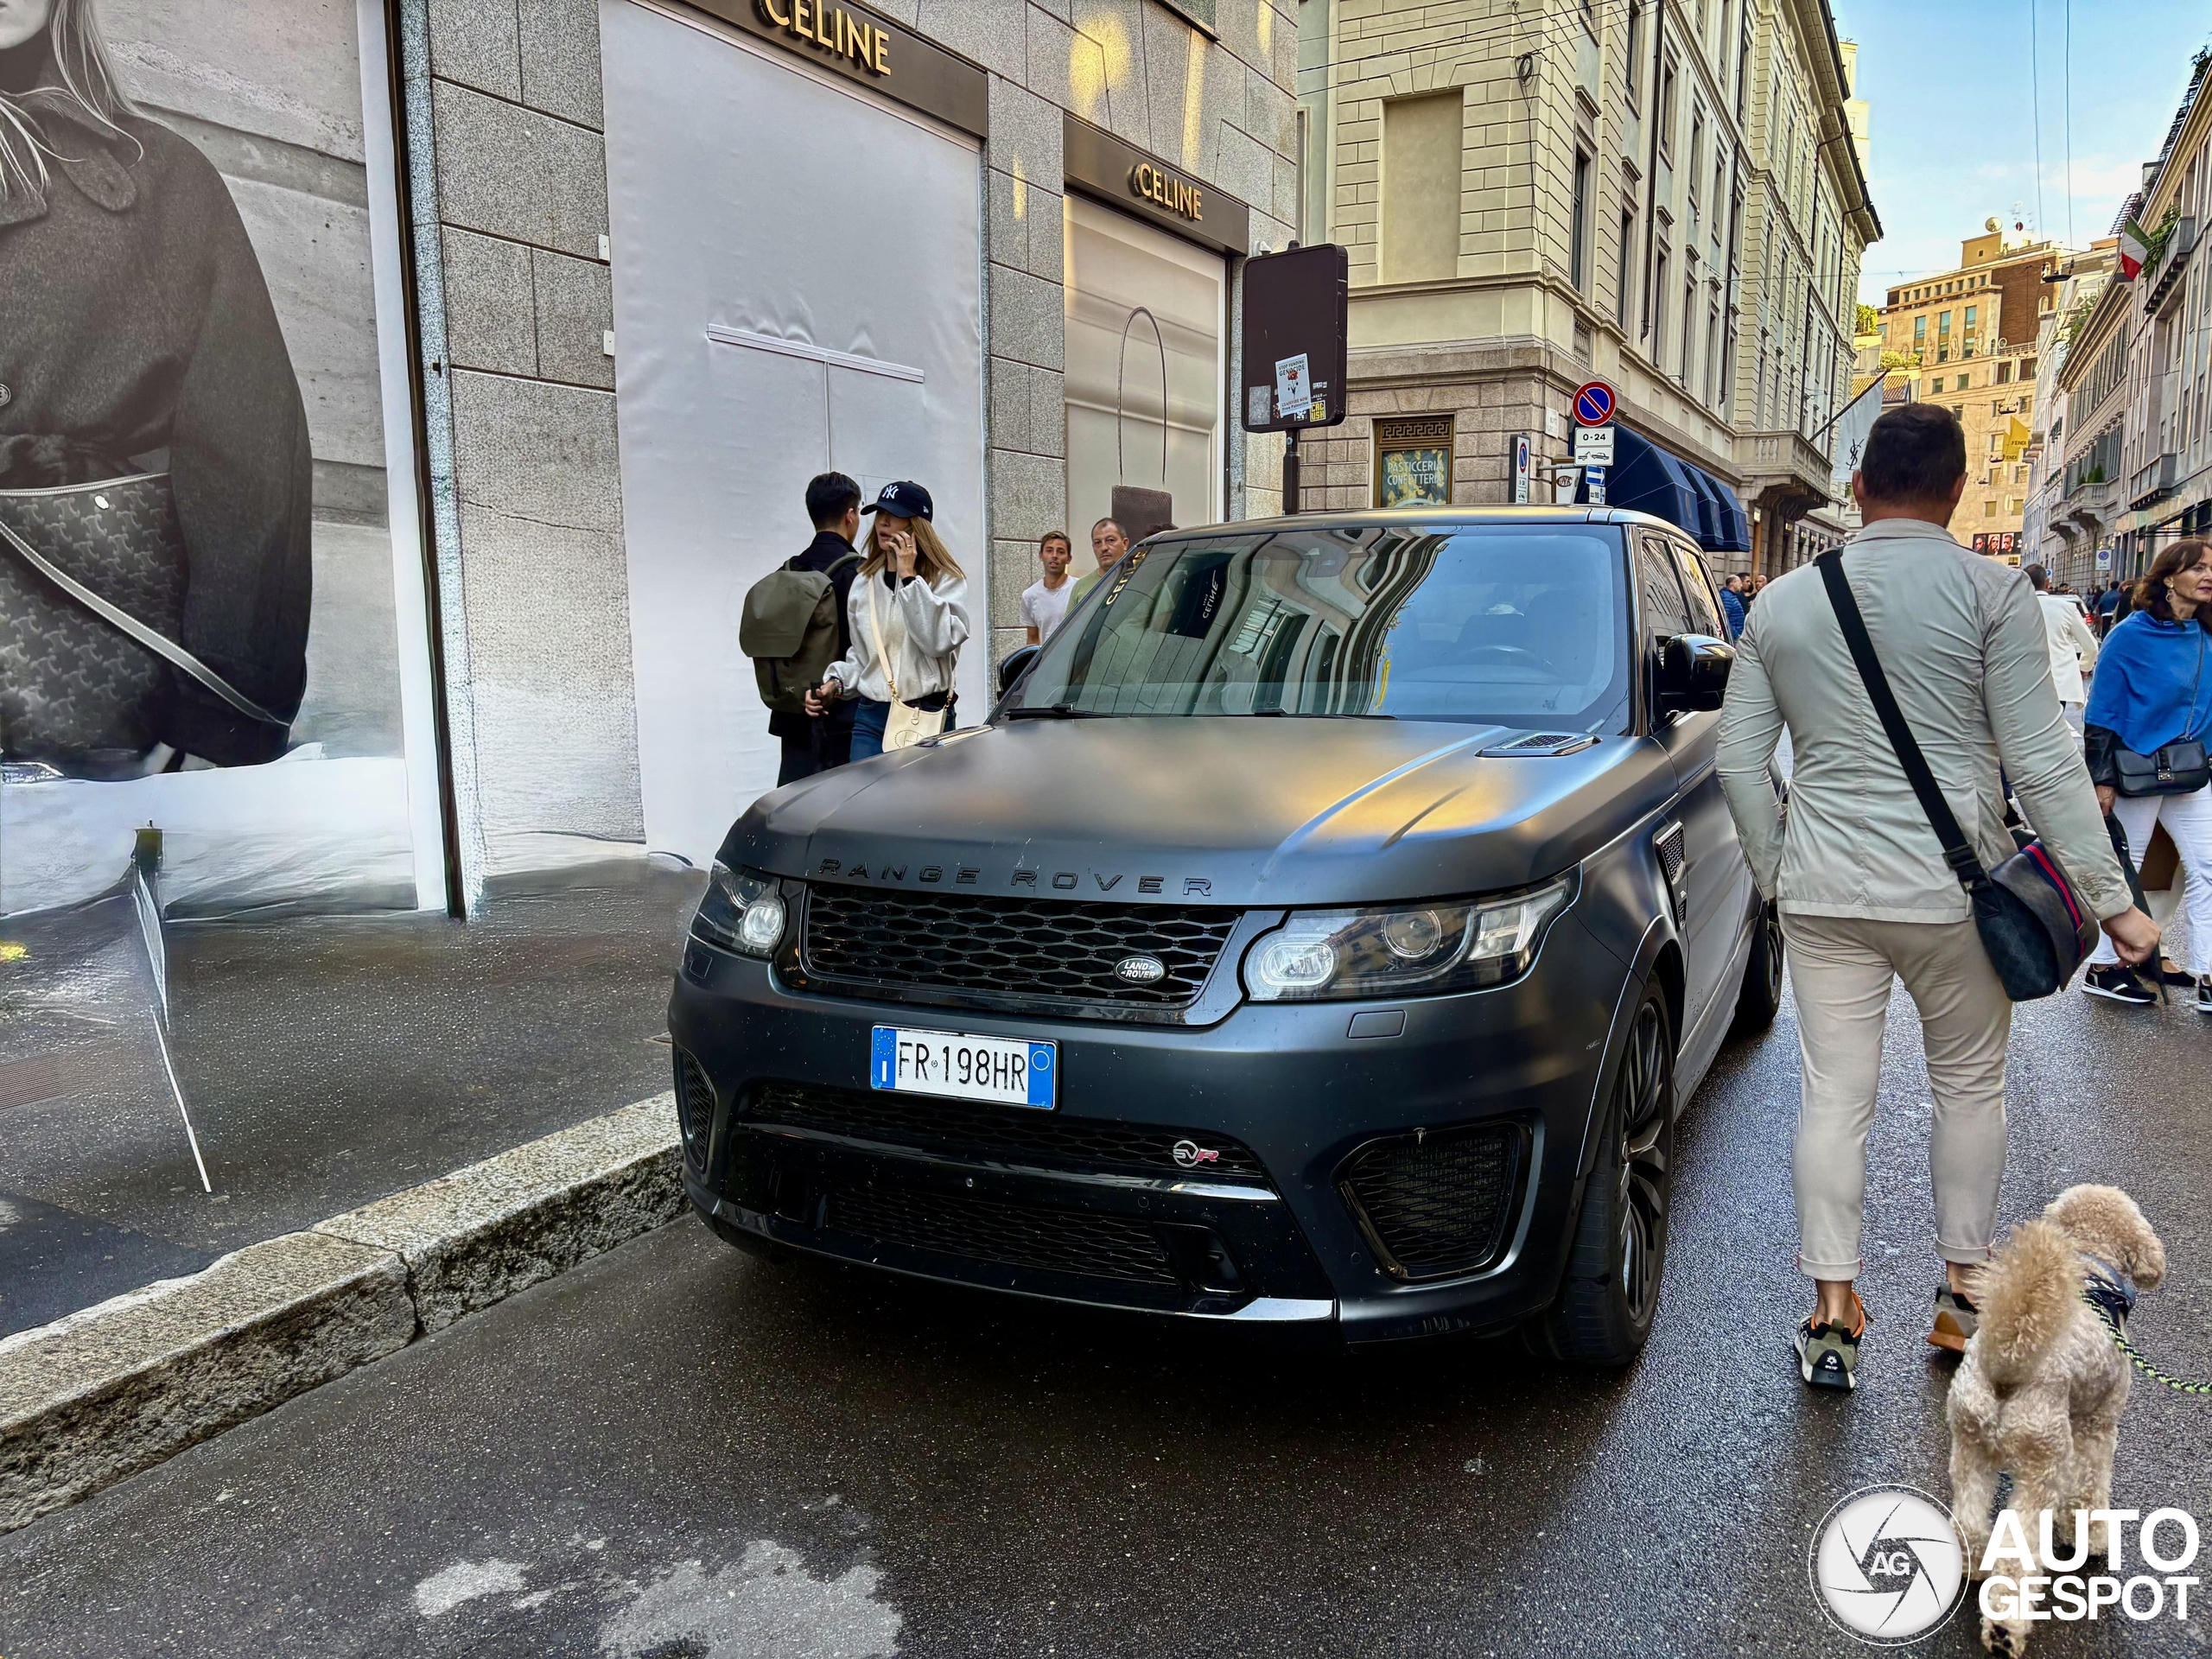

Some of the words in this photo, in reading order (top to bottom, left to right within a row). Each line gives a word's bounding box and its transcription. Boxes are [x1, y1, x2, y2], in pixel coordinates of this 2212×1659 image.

[1138, 162, 1203, 221] CELINE
[1279, 364, 1306, 376] GENOCIDE
[1387, 461, 1442, 473] PASTICCERIA
[1387, 473, 1442, 486] CONFETTERIA
[817, 858, 981, 884] RANGE
[1010, 869, 1212, 897] ROVER
[1123, 961, 1149, 970] LAND
[1125, 969, 1156, 979] ROVER
[1173, 1141, 1219, 1165] SVR
